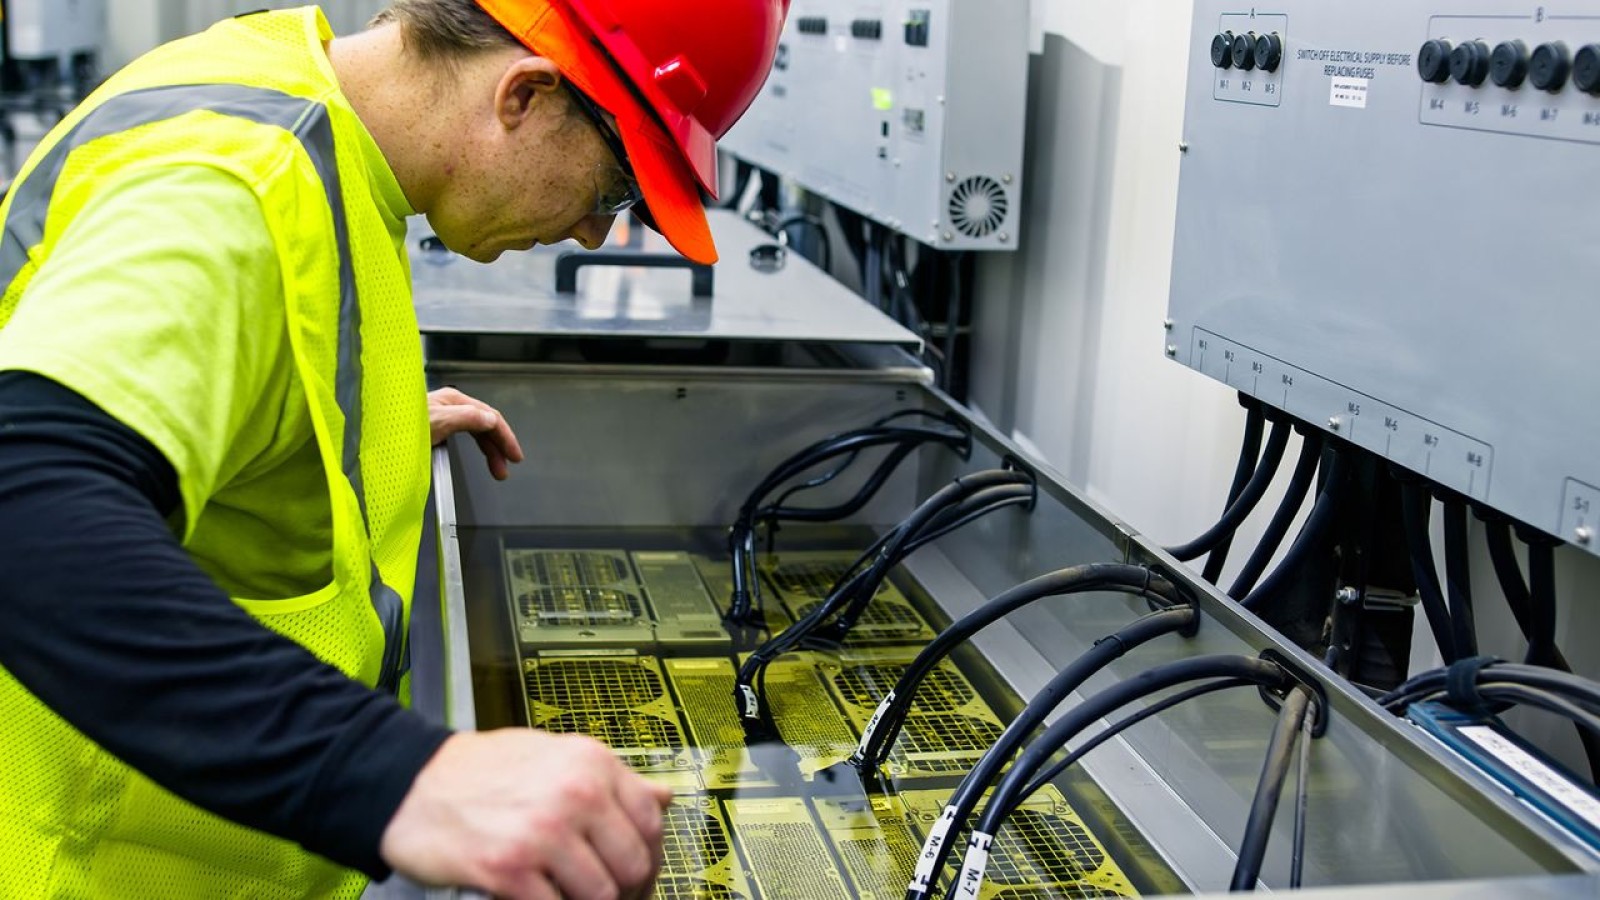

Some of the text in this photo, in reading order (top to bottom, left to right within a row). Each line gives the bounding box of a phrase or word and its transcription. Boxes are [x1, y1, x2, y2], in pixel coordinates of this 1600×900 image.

[1249, 8, 1256, 19] A
[1297, 49, 1411, 66] SWITCH OFF ELECTRICAL SUPPLY BEFORE
[1324, 65, 1375, 79] REPLACING FUSES
[1241, 82, 1252, 91] M-2
[1265, 84, 1275, 94] M-3
[1224, 349, 1235, 363] M-2
[1252, 361, 1263, 375] M-3
[1347, 401, 1360, 416] M-5
[924, 835, 942, 860] M-6
[962, 867, 981, 896] M-7
